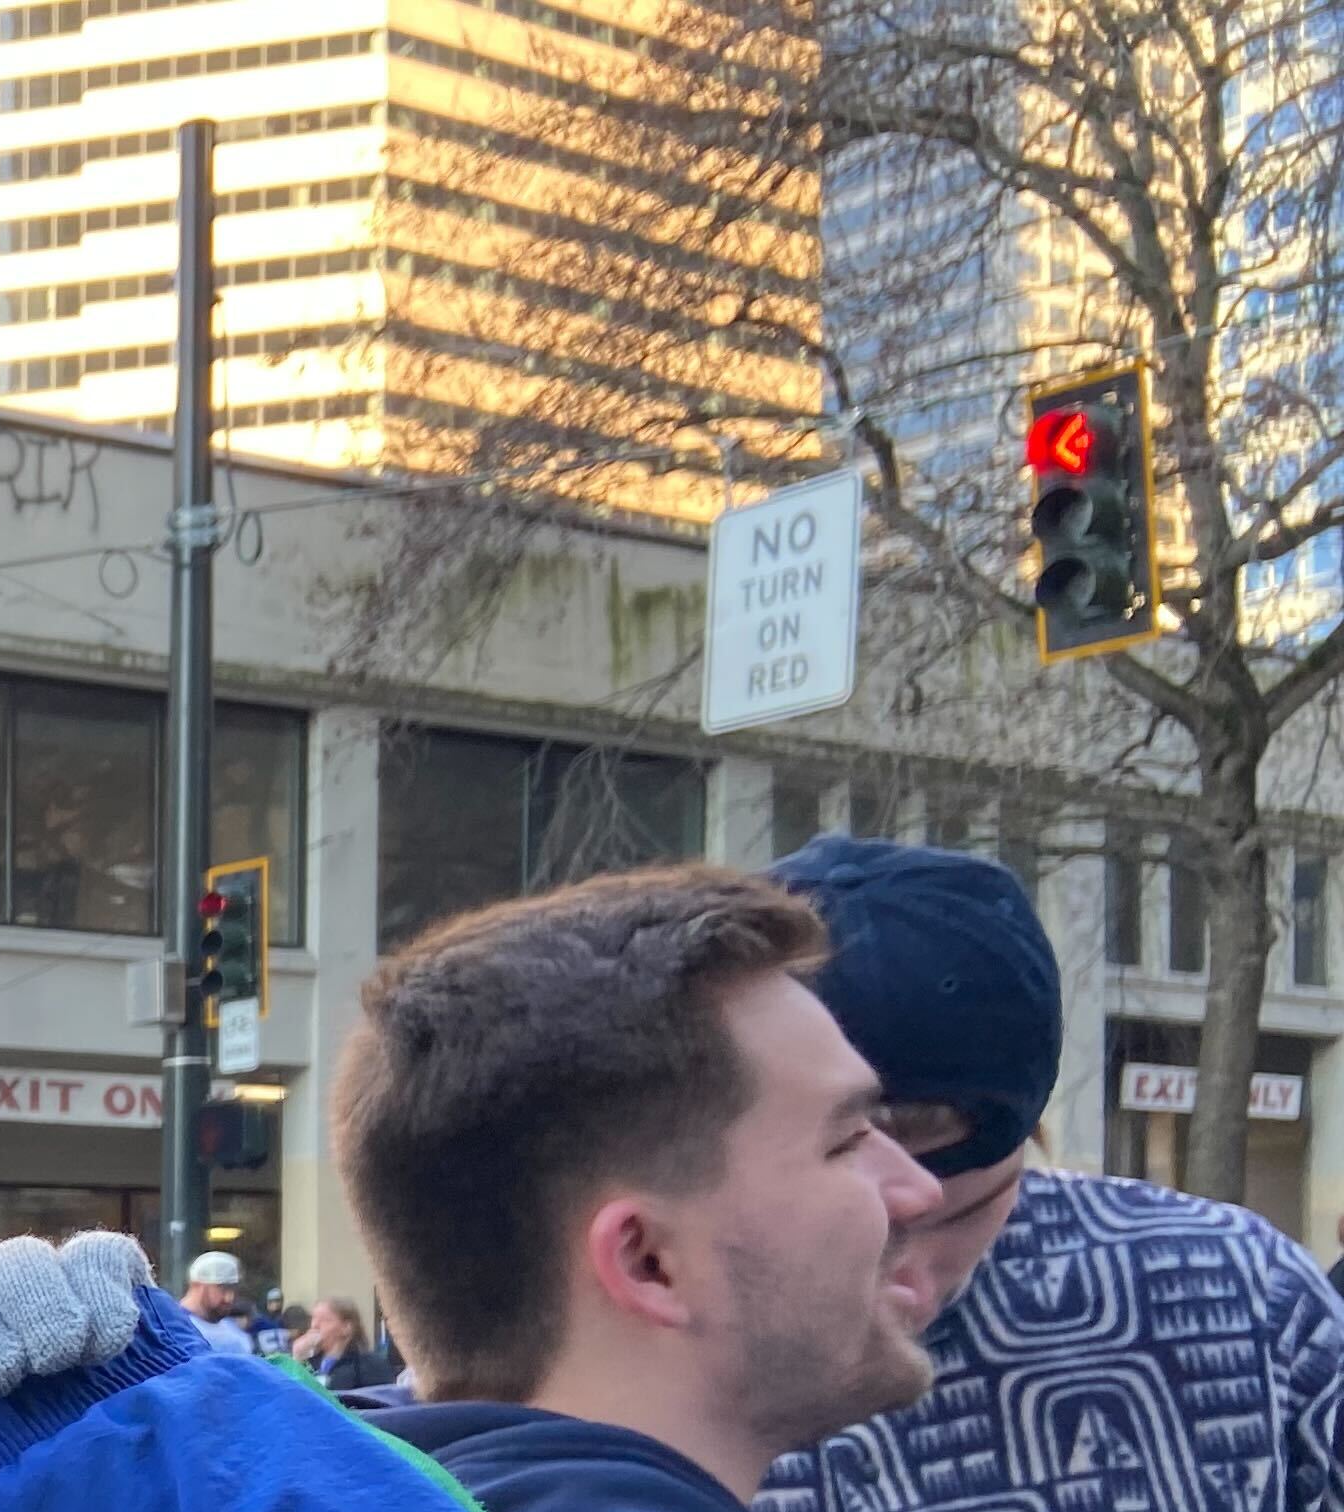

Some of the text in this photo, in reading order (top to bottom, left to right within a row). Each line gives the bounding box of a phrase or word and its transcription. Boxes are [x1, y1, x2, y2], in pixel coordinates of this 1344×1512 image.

[752, 512, 816, 566] NO
[740, 563, 823, 612] TURN
[758, 612, 801, 653] ON
[747, 653, 809, 700] RED
[103, 1084, 162, 1118] ON
[1134, 1074, 1197, 1102] EXI
